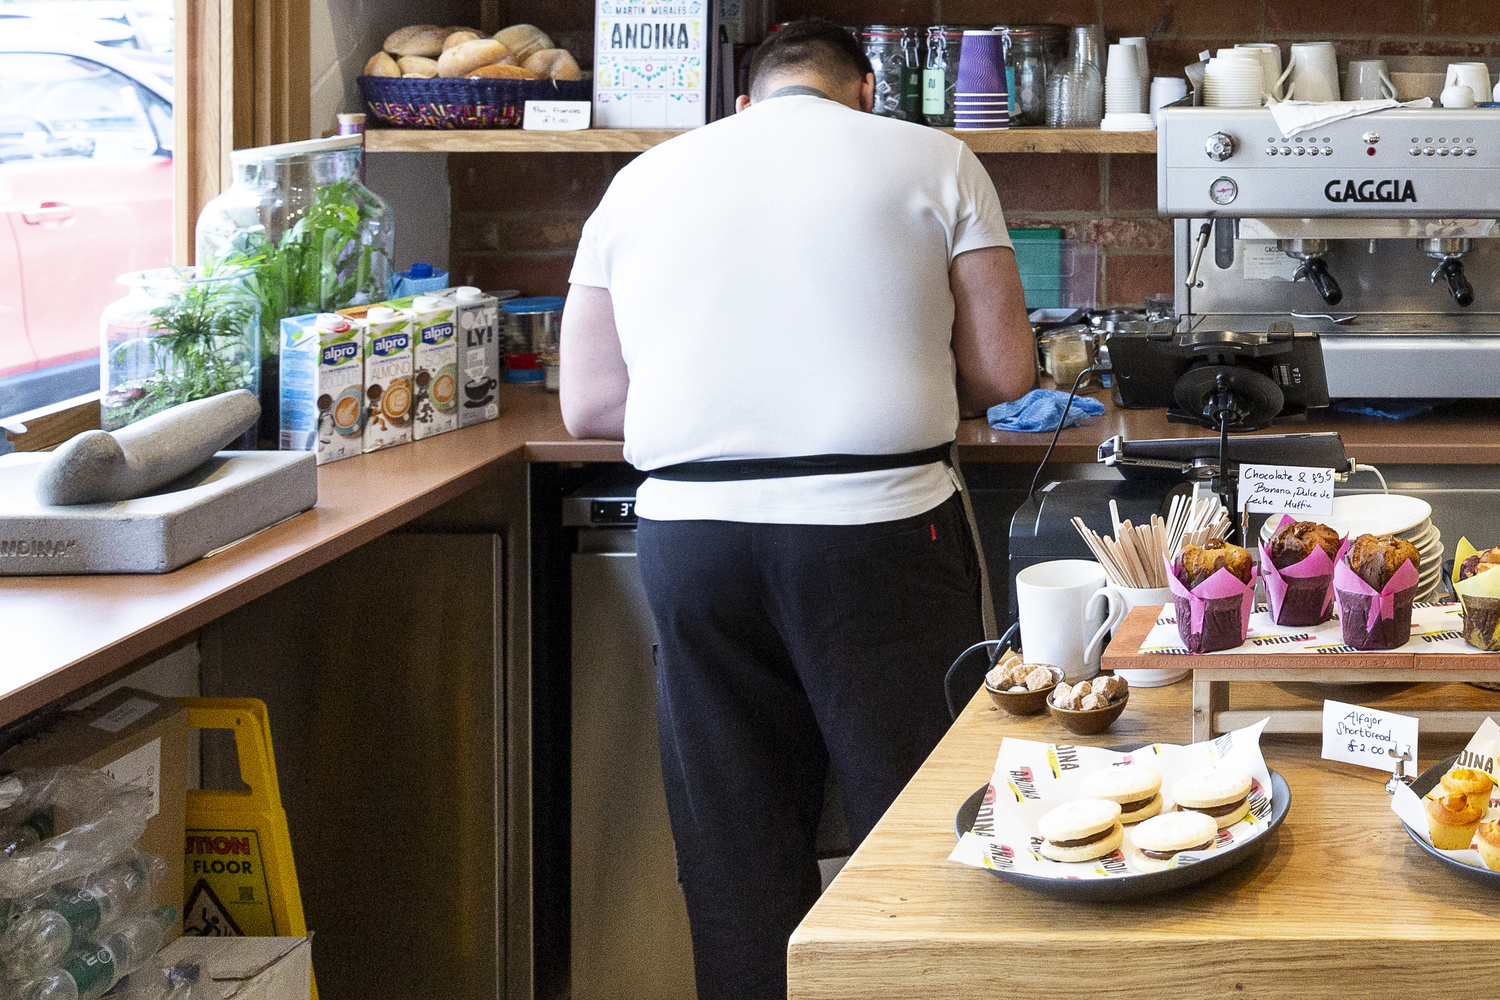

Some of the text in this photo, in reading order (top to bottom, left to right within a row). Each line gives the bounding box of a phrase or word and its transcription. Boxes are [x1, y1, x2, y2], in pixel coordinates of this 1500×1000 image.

[615, 6, 687, 15] MARTIN MORALES
[611, 23, 689, 50] ANDINA
[1324, 179, 1417, 203] GAGGIA
[424, 326, 452, 340] alpro
[375, 337, 406, 352] alpro
[324, 346, 355, 360] alpro
[372, 362, 411, 380] ALMOND
[1244, 468, 1307, 483] Chocolate &
[1296, 487, 1331, 499] Dulce de
[1246, 495, 1312, 509] Leche Muffin
[1343, 711, 1382, 729] Alfajor
[1336, 721, 1391, 742] Shortbread
[1010, 769, 1041, 800] ANDINA
[193, 860, 252, 874] FLOOR
